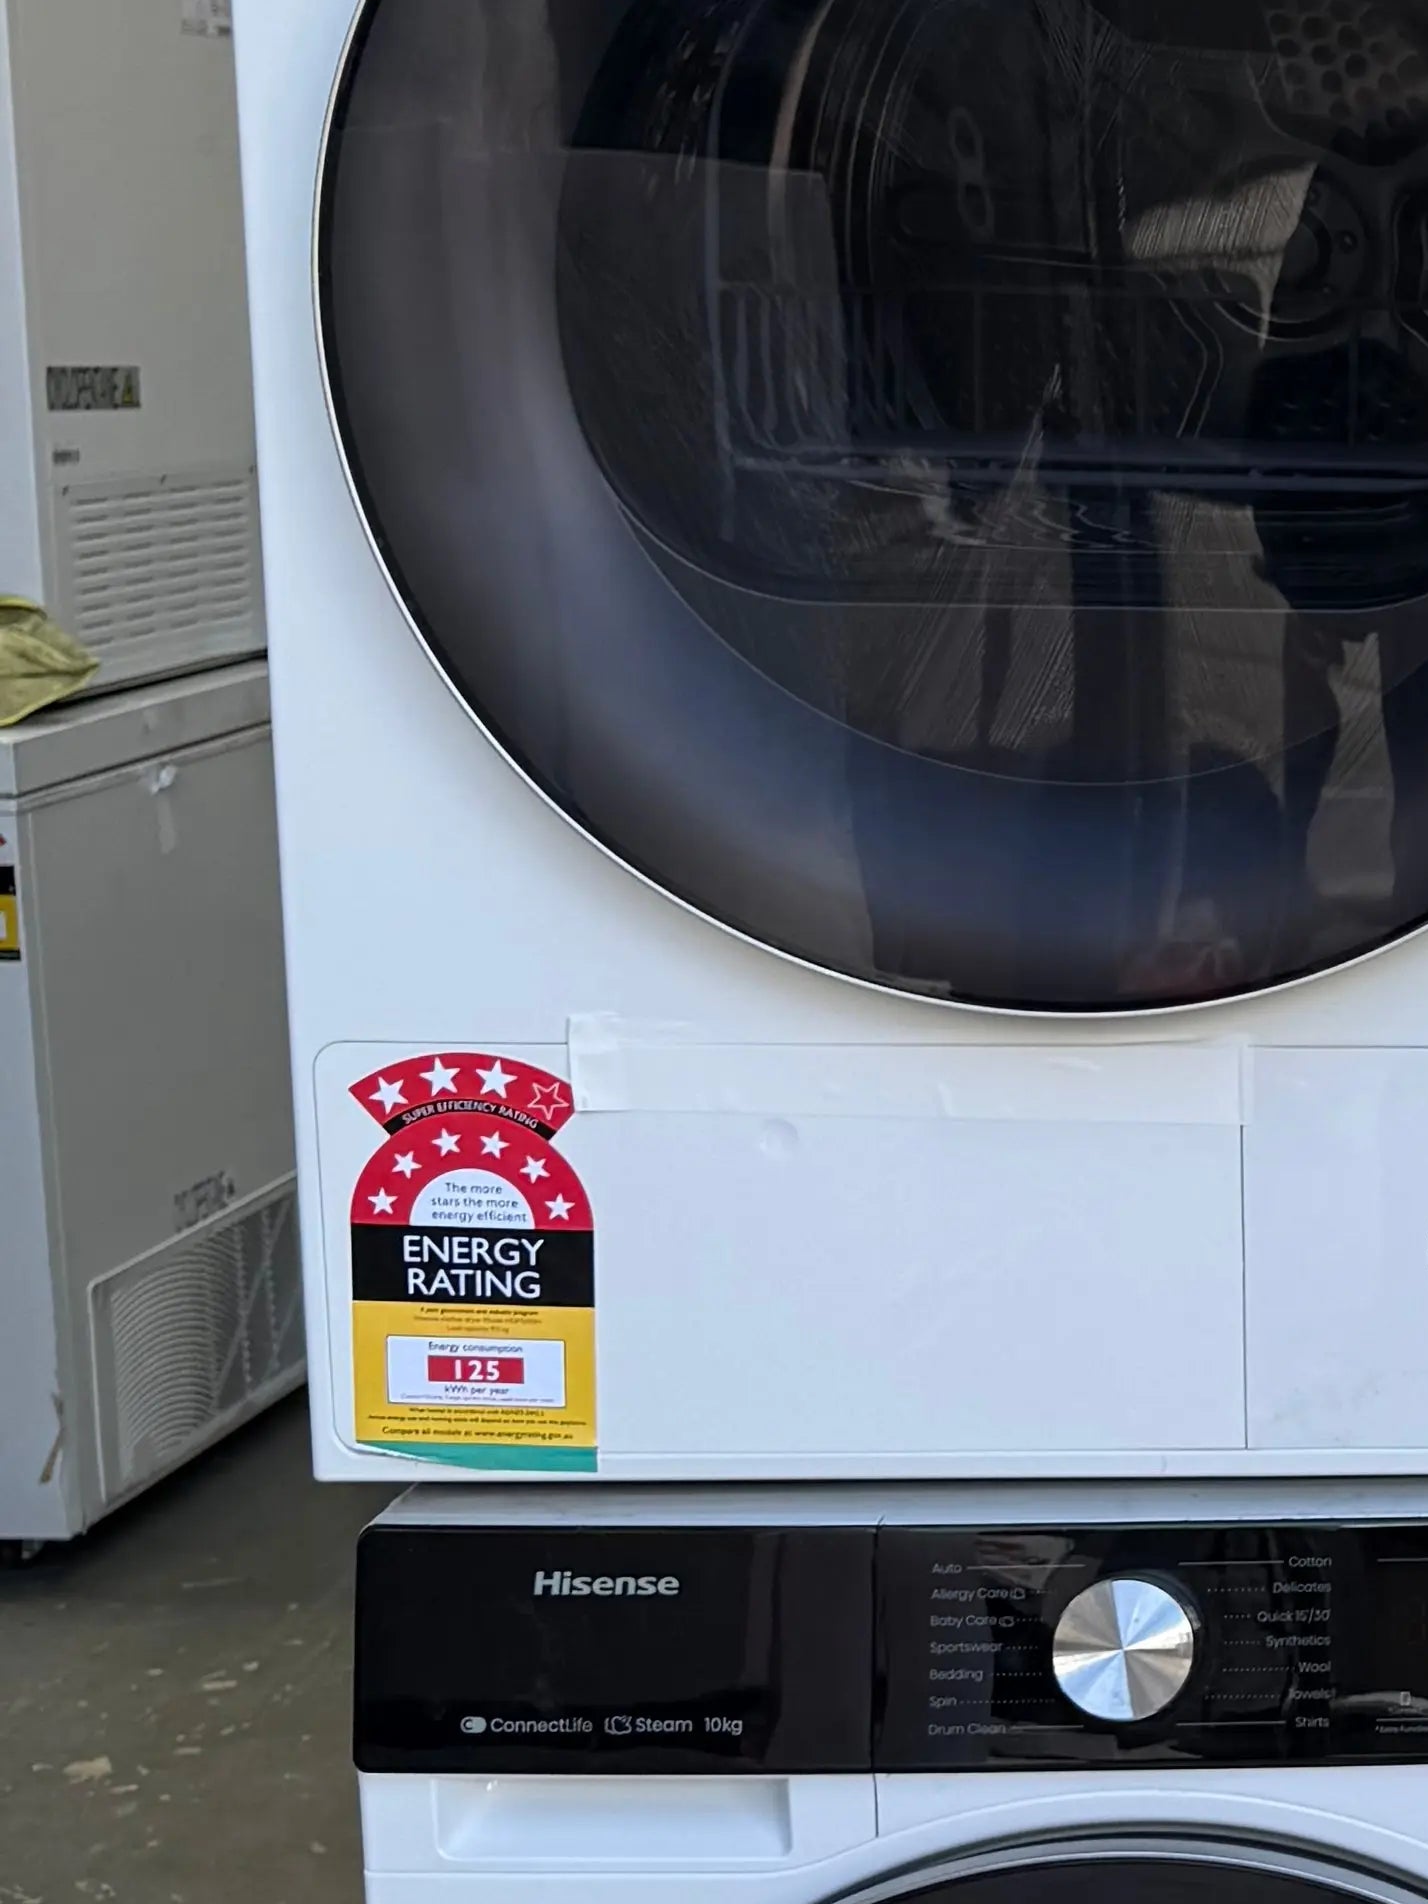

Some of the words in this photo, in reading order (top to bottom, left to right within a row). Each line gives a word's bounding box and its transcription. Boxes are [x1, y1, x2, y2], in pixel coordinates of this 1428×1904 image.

[402, 1106, 435, 1125] SUPER
[437, 1101, 497, 1113] EFFICIENCY
[498, 1103, 538, 1128] RATING
[445, 1182, 467, 1193] The
[470, 1185, 502, 1194] more
[431, 1197, 460, 1207] stars
[463, 1195, 484, 1208] the
[486, 1199, 518, 1208] more
[432, 1211, 473, 1223] energy
[477, 1212, 527, 1222] efficient
[403, 1235, 544, 1265] ENERGY
[407, 1269, 541, 1298] RATING
[428, 1342, 459, 1352] Energy
[455, 1360, 500, 1381] 125
[1289, 1556, 1332, 1567] Cotton
[932, 1563, 962, 1574] Auto
[534, 1571, 680, 1597] Hisense
[1273, 1582, 1332, 1594] Delicates
[931, 1588, 975, 1602] Allergy
[977, 1588, 1008, 1600] Care
[930, 1615, 964, 1628] Baby
[965, 1615, 997, 1626] Care
[930, 1642, 1003, 1654] Sportswear
[1265, 1635, 1331, 1649] Synthetics
[1299, 1661, 1331, 1672] Wool
[929, 1669, 983, 1682] Bedding
[929, 1696, 957, 1708] Spin
[490, 1716, 593, 1735] ConnectLife
[635, 1717, 693, 1734] Steam
[705, 1717, 743, 1737] 10kg
[1295, 1717, 1330, 1728] Shirts
[929, 1724, 965, 1735] Drum
[968, 1723, 1007, 1734] Clean
